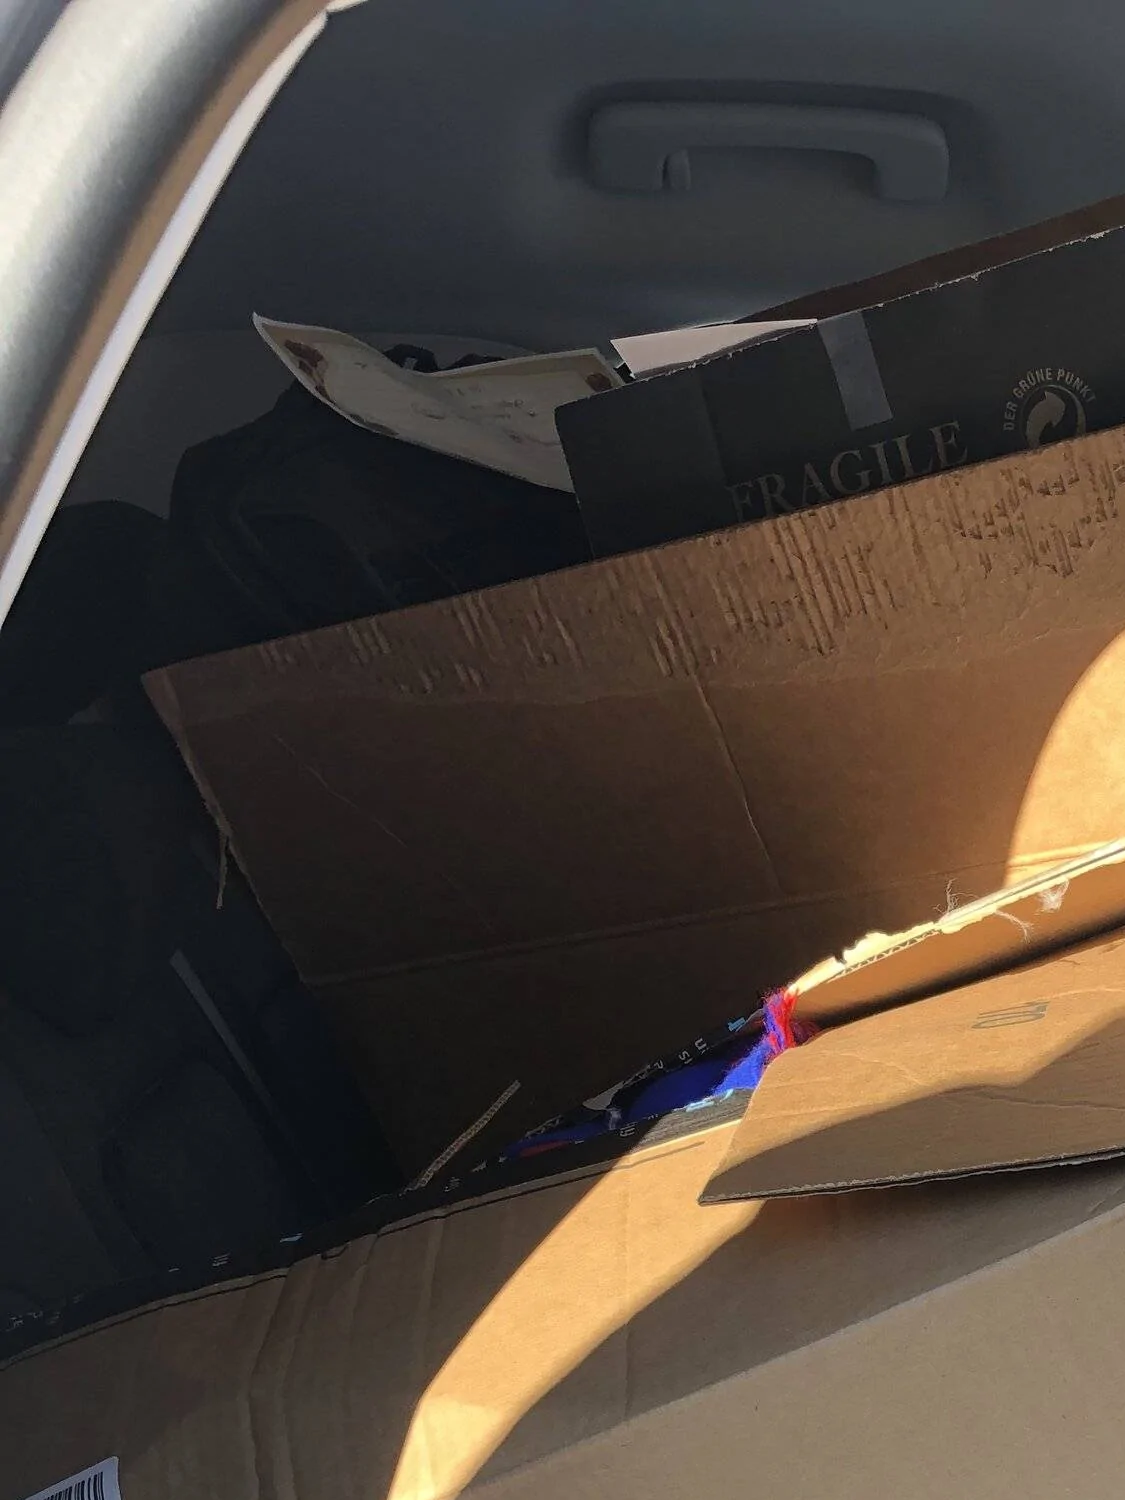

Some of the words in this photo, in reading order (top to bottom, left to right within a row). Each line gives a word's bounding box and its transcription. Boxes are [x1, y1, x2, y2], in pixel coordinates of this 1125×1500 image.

[1003, 401, 1018, 431] DER
[1056, 367, 1096, 403] PUNKT
[724, 420, 968, 524] FRAGILE
